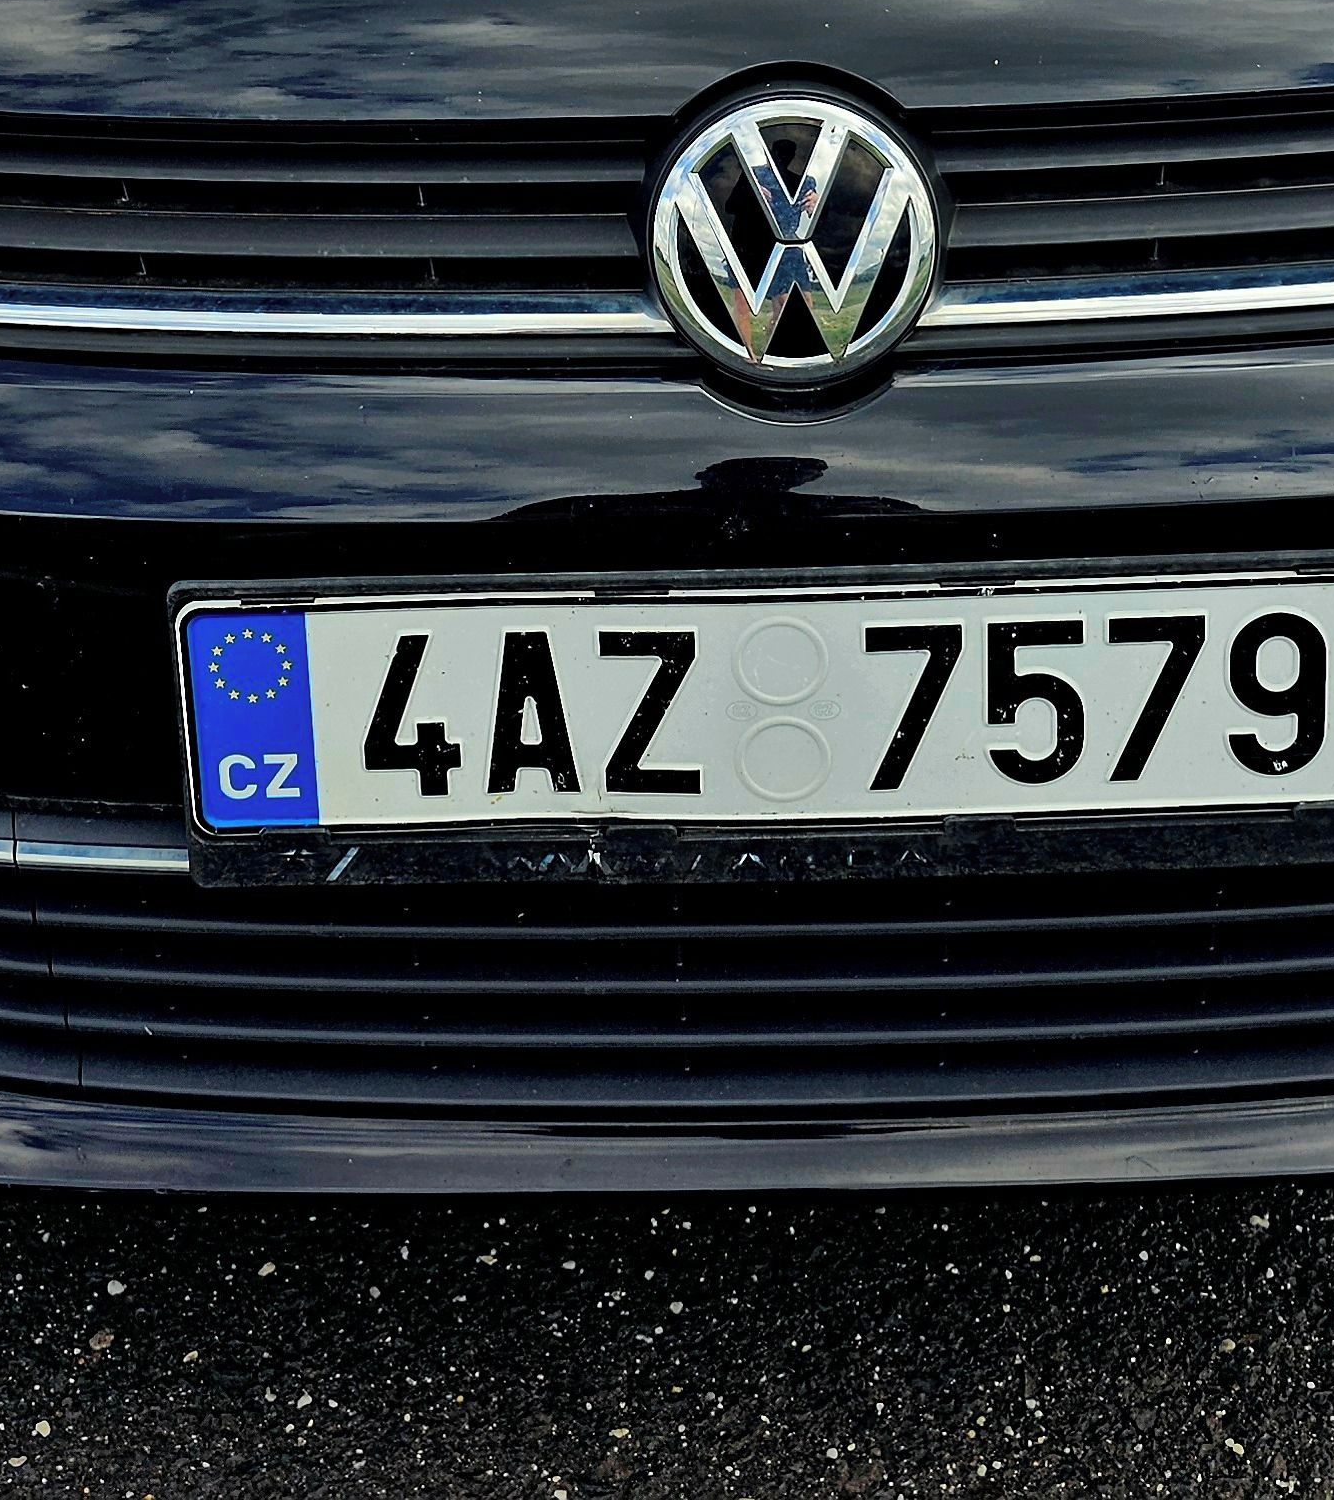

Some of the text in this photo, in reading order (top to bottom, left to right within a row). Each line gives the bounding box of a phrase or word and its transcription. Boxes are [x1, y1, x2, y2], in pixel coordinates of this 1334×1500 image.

[657, 102, 931, 368] VW
[218, 753, 301, 799] CZ
[362, 612, 1328, 798] 4AZ 7579
